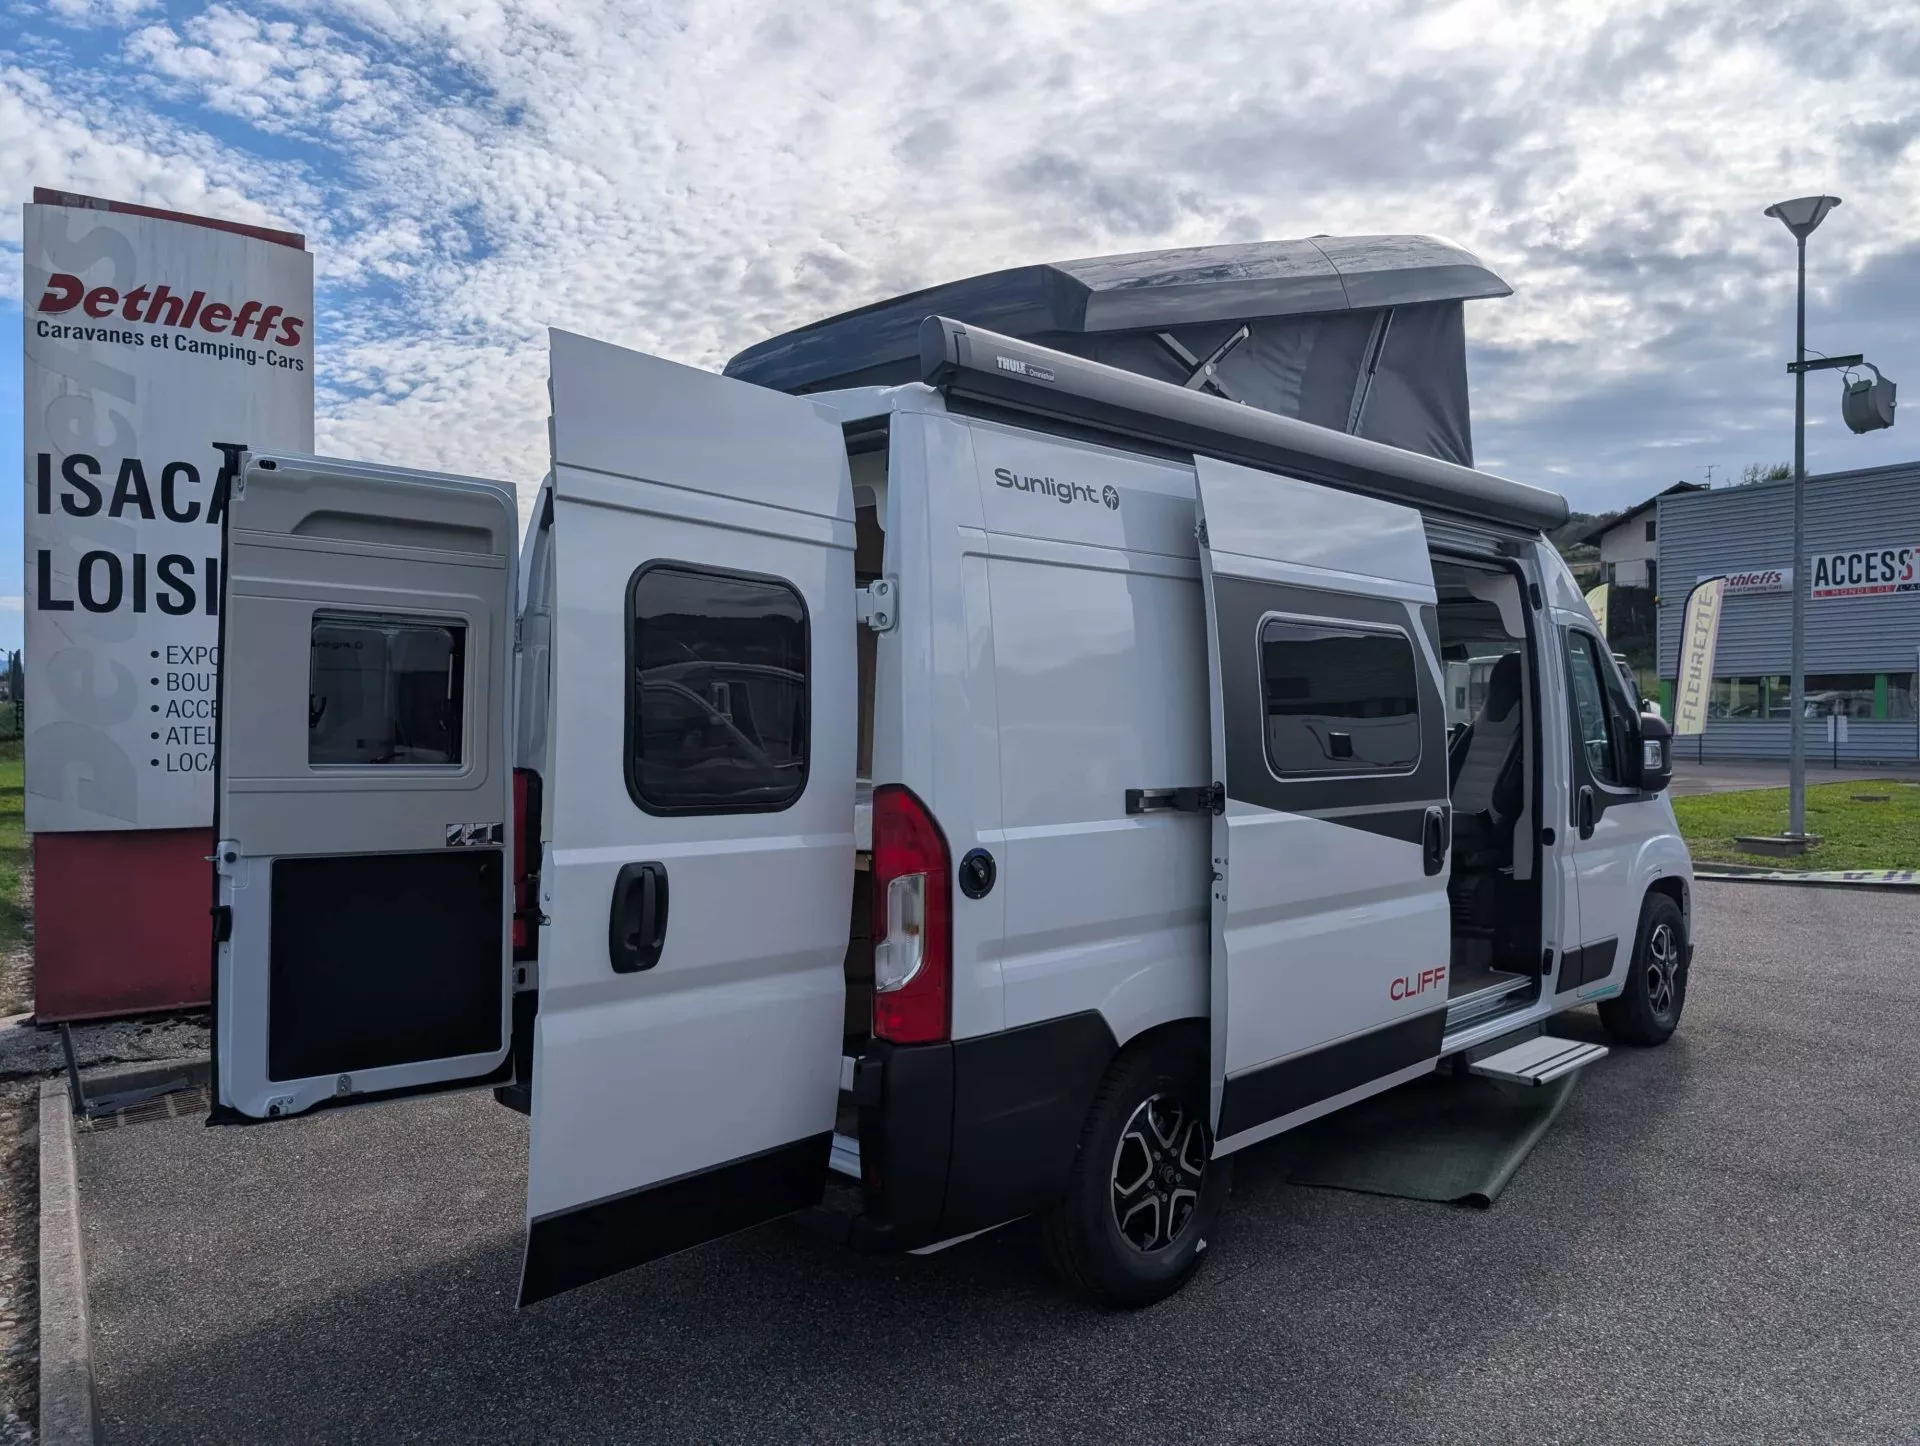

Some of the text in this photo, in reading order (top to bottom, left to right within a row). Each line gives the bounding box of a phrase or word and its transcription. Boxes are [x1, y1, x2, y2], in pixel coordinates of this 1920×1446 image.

[37, 273, 304, 347] Dethleffs
[37, 320, 304, 372] Caravanes et Camping-Cars
[996, 355, 1026, 375] THULE
[994, 467, 1100, 504] Sunlight
[1832, 587, 1871, 595] MONDE
[1899, 583, 1920, 591] L'A
[1683, 594, 1713, 721] FLEURETTE
[1390, 966, 1446, 1001] CLIFF
